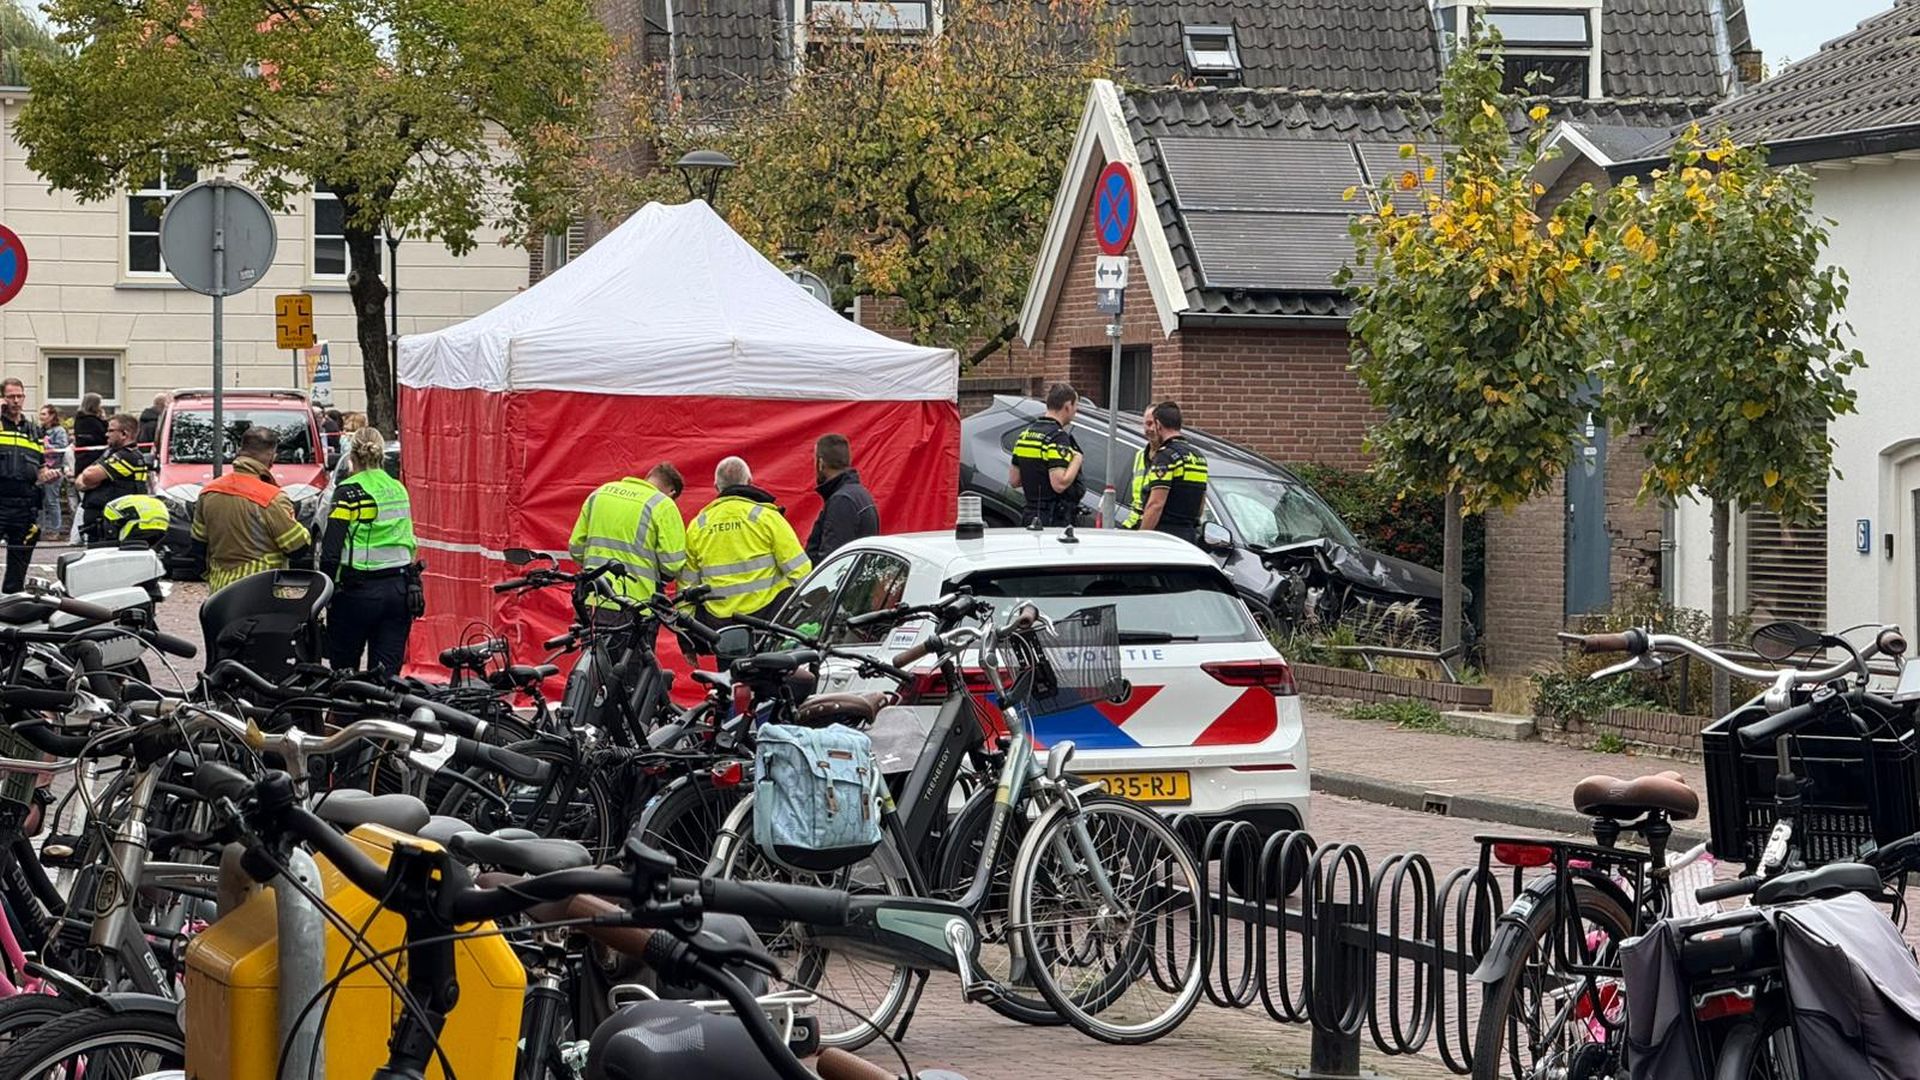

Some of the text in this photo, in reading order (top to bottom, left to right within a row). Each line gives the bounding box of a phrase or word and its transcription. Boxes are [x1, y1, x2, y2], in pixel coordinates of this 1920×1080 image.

[603, 485, 637, 497] STEDIN
[1066, 649, 1164, 662] POLTIE
[924, 749, 950, 800] TRENERGY
[985, 812, 1005, 870] Gazelle
